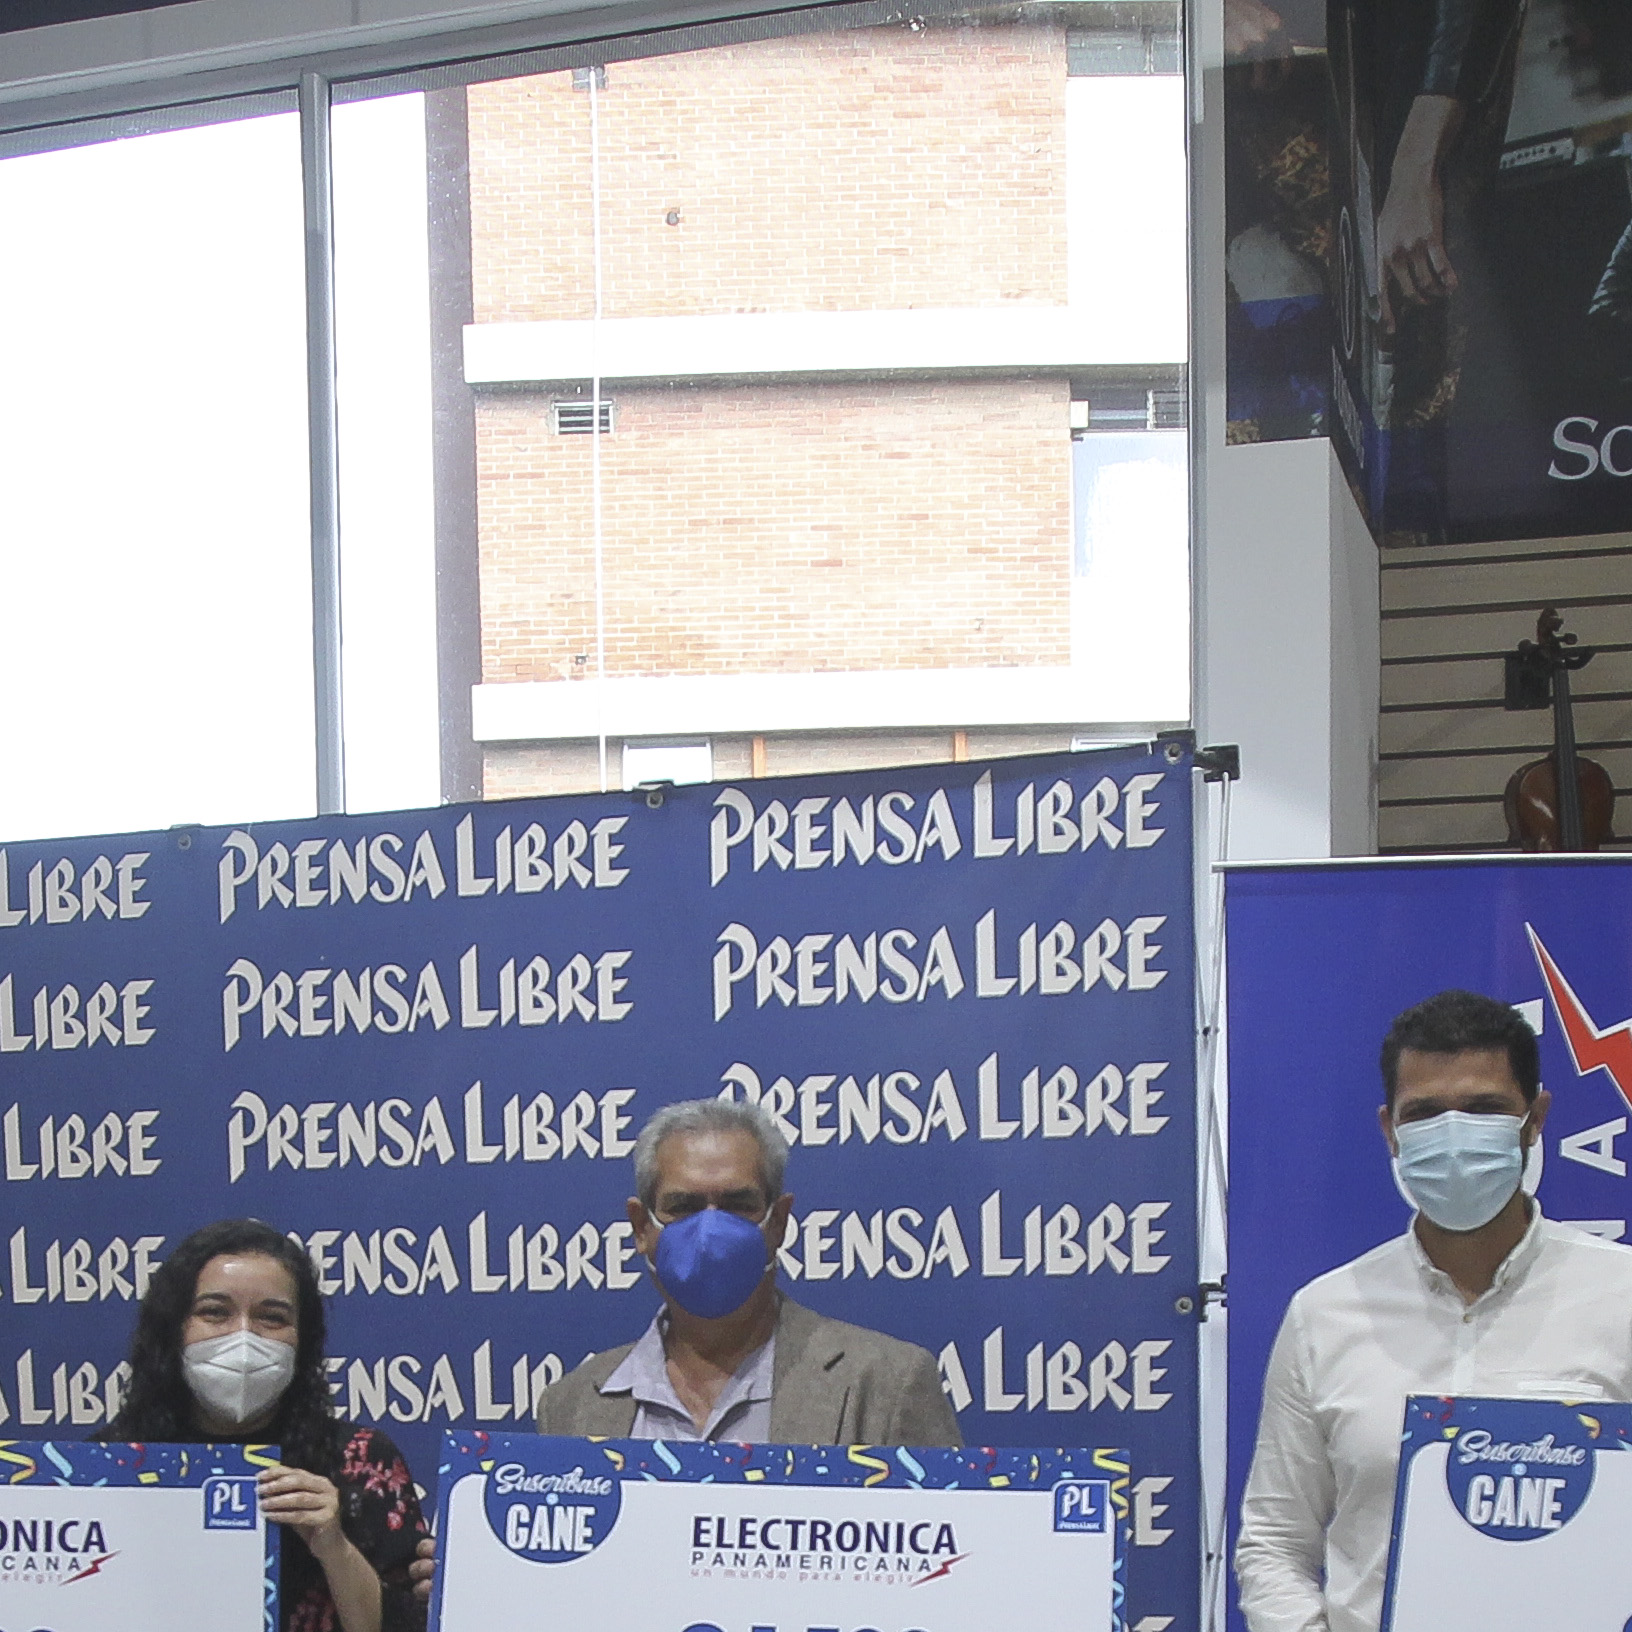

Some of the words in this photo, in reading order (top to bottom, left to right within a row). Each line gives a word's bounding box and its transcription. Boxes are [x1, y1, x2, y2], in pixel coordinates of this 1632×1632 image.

[219, 830, 445, 924] PRENSA
[456, 813, 629, 896] LIBRE
[710, 787, 962, 888] PRENSA
[973, 769, 1166, 858] LIBRE
[224, 958, 449, 1051] PRENSA
[459, 944, 633, 1028] LIBRE
[712, 922, 964, 1022] PRENSA
[975, 908, 1167, 999] LIBRE
[228, 1090, 454, 1184] PRENSA
[464, 1080, 637, 1163] LIBRE
[978, 1052, 1170, 1140] LIBRE
[4, 1102, 161, 1181] LIBRE
[287, 1225, 459, 1296] ENSA
[469, 1210, 642, 1293] LIBRE
[775, 1204, 970, 1280] RENSA
[980, 1189, 1172, 1277] LIBRE
[17, 1348, 132, 1425] LIBR
[321, 1354, 464, 1422] ENSA
[982, 1326, 1174, 1414] LIBRE
[213, 1481, 247, 1515] PL
[692, 1516, 958, 1554] ELECTRONICA
[1062, 1485, 1097, 1518] PL
[691, 1551, 931, 1572] PANAMERICANA
[723, 1569, 787, 1580] mundo
